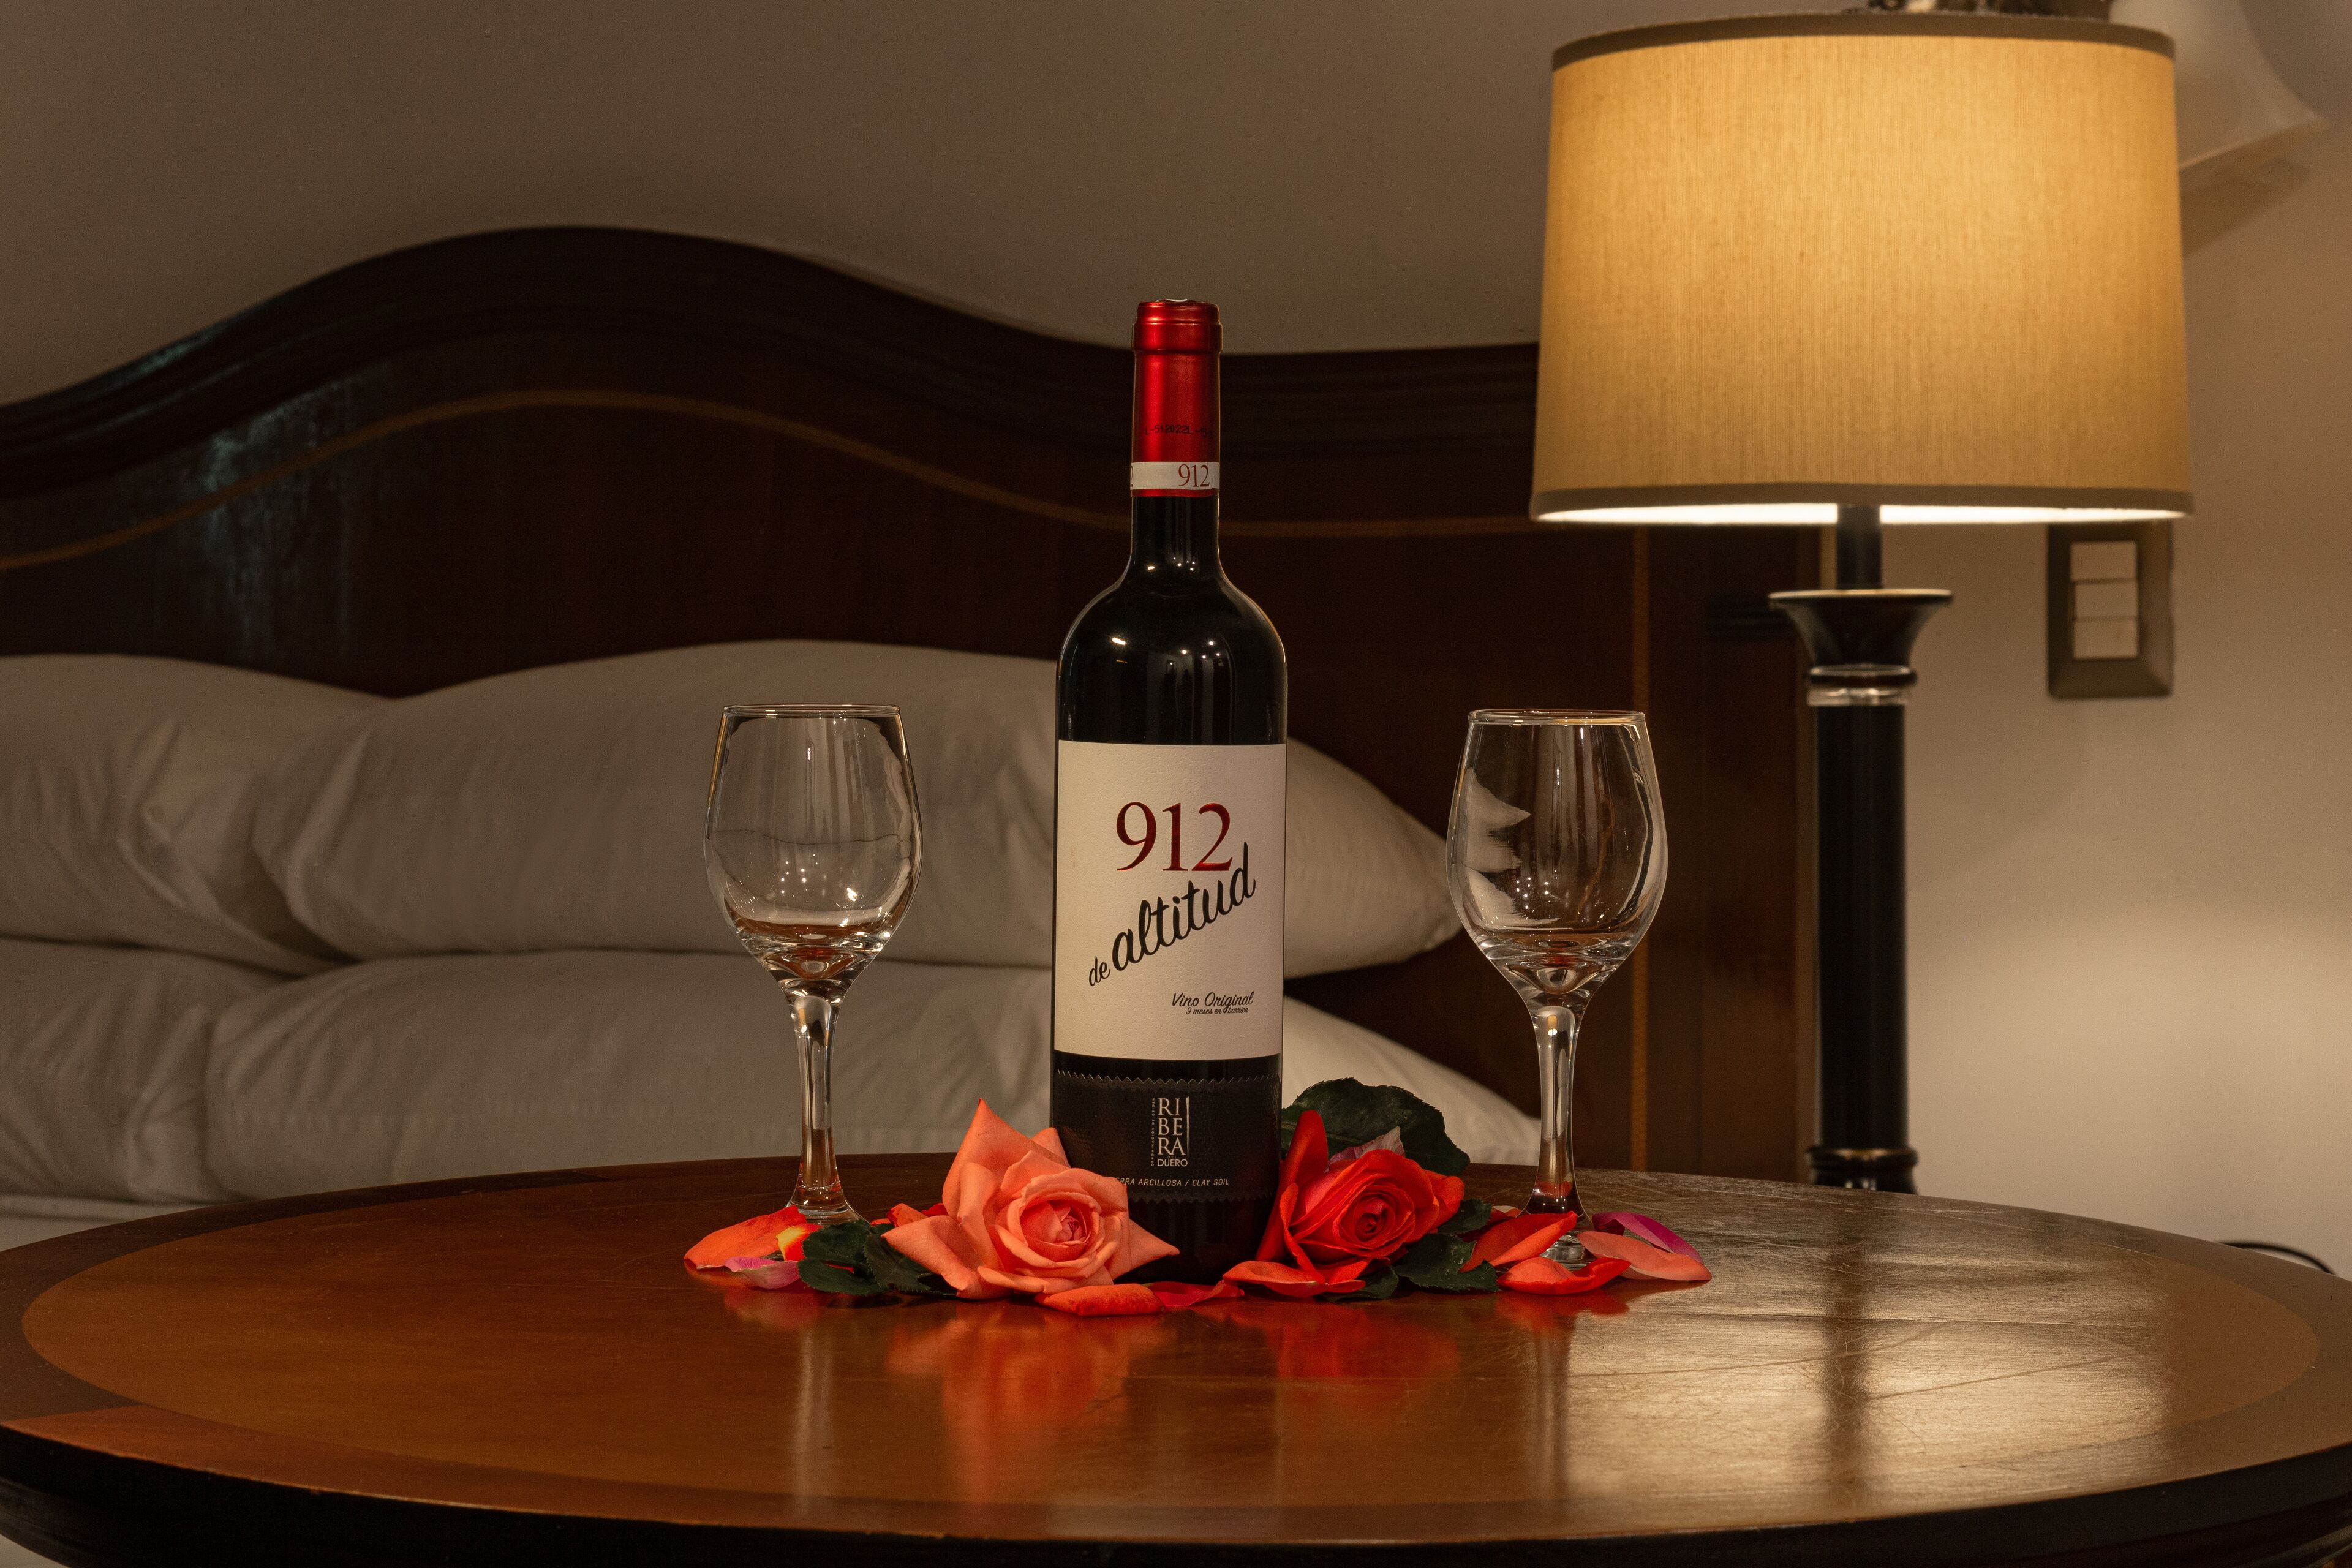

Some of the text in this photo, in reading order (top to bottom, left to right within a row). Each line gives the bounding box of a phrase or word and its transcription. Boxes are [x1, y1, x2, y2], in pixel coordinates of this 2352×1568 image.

[1178, 464, 1210, 488] 912
[1116, 801, 1233, 872] 912
[1088, 842, 1256, 987] de altitud
[1172, 990, 1254, 1014] Vino Original
